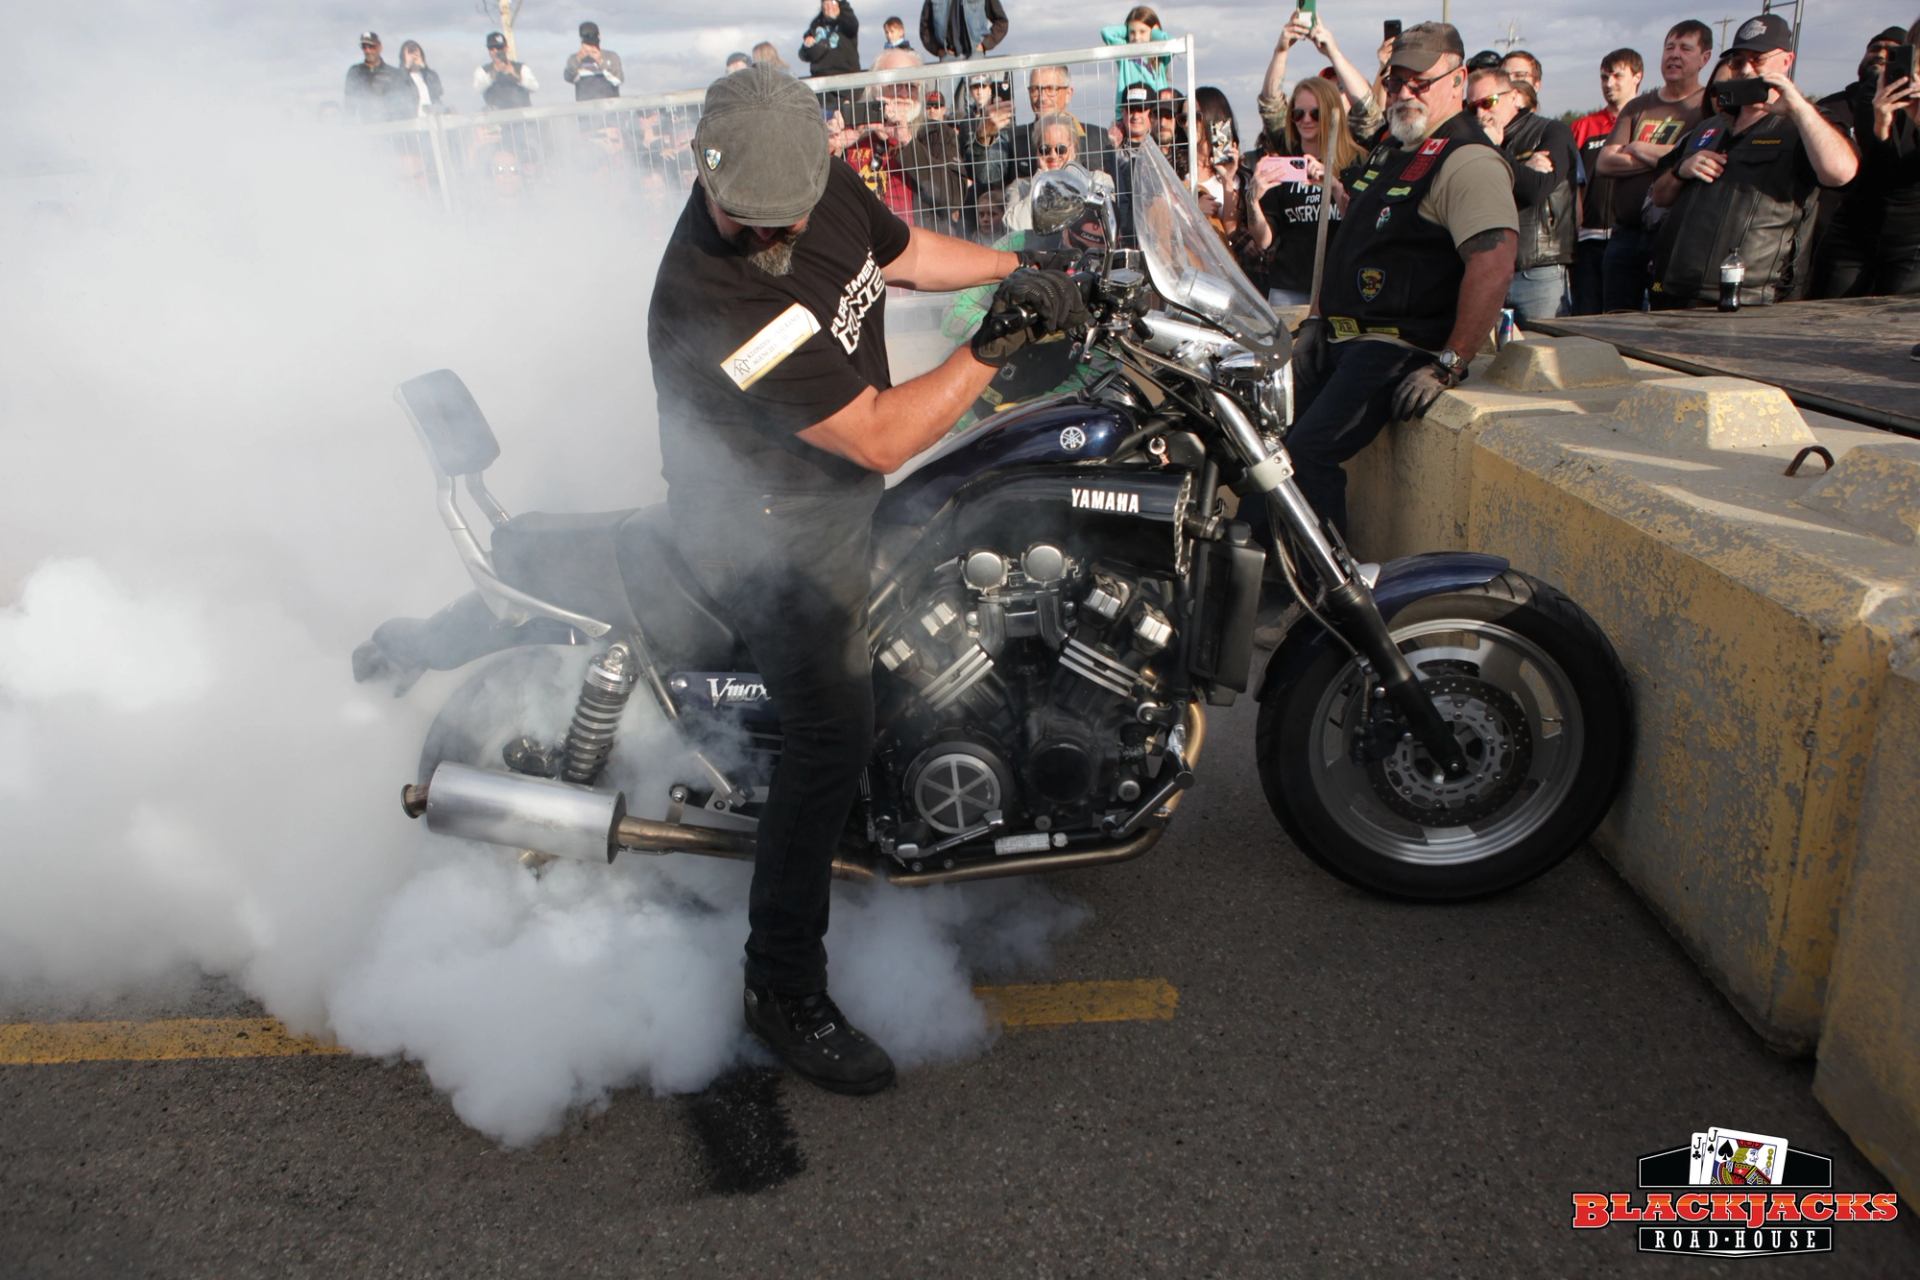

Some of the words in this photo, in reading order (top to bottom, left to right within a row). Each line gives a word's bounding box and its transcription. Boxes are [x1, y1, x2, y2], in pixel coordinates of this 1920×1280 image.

[1305, 194, 1321, 204] FOR
[1284, 203, 1342, 223] EVERYN
[830, 249, 875, 338] SUPPEMEN
[1071, 488, 1139, 513] YAMAHA
[706, 677, 772, 708] Vmax
